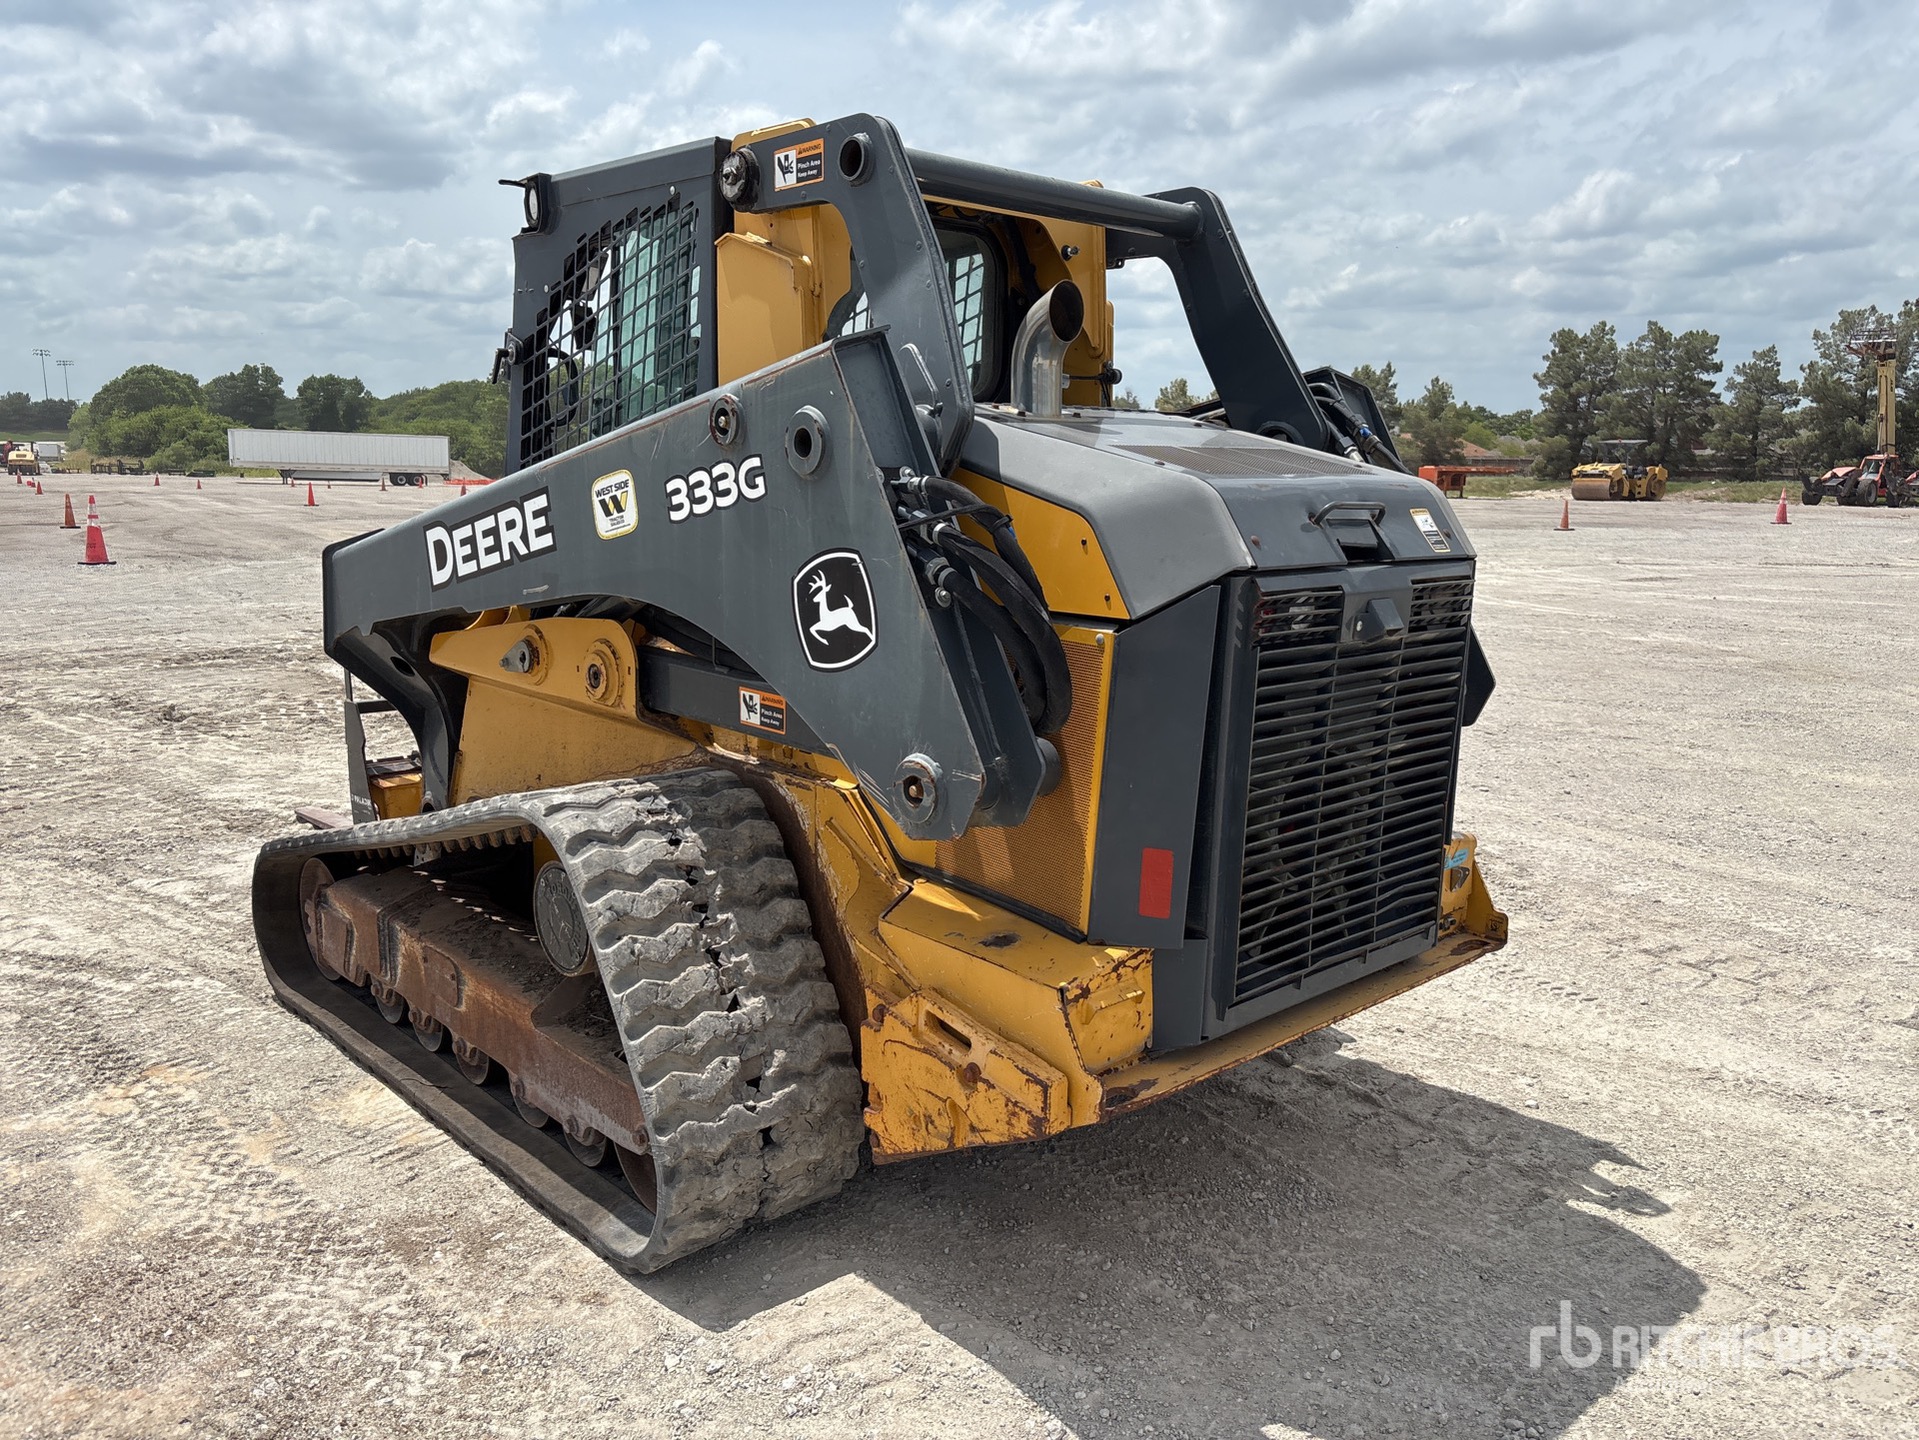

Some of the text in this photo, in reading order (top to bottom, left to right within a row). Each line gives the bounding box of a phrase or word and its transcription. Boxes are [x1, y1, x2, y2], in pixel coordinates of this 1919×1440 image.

[797, 159, 821, 169] Pinch Area
[595, 479, 630, 498] WEST SIDE
[665, 456, 767, 522] 333G
[424, 493, 555, 587] DEERE
